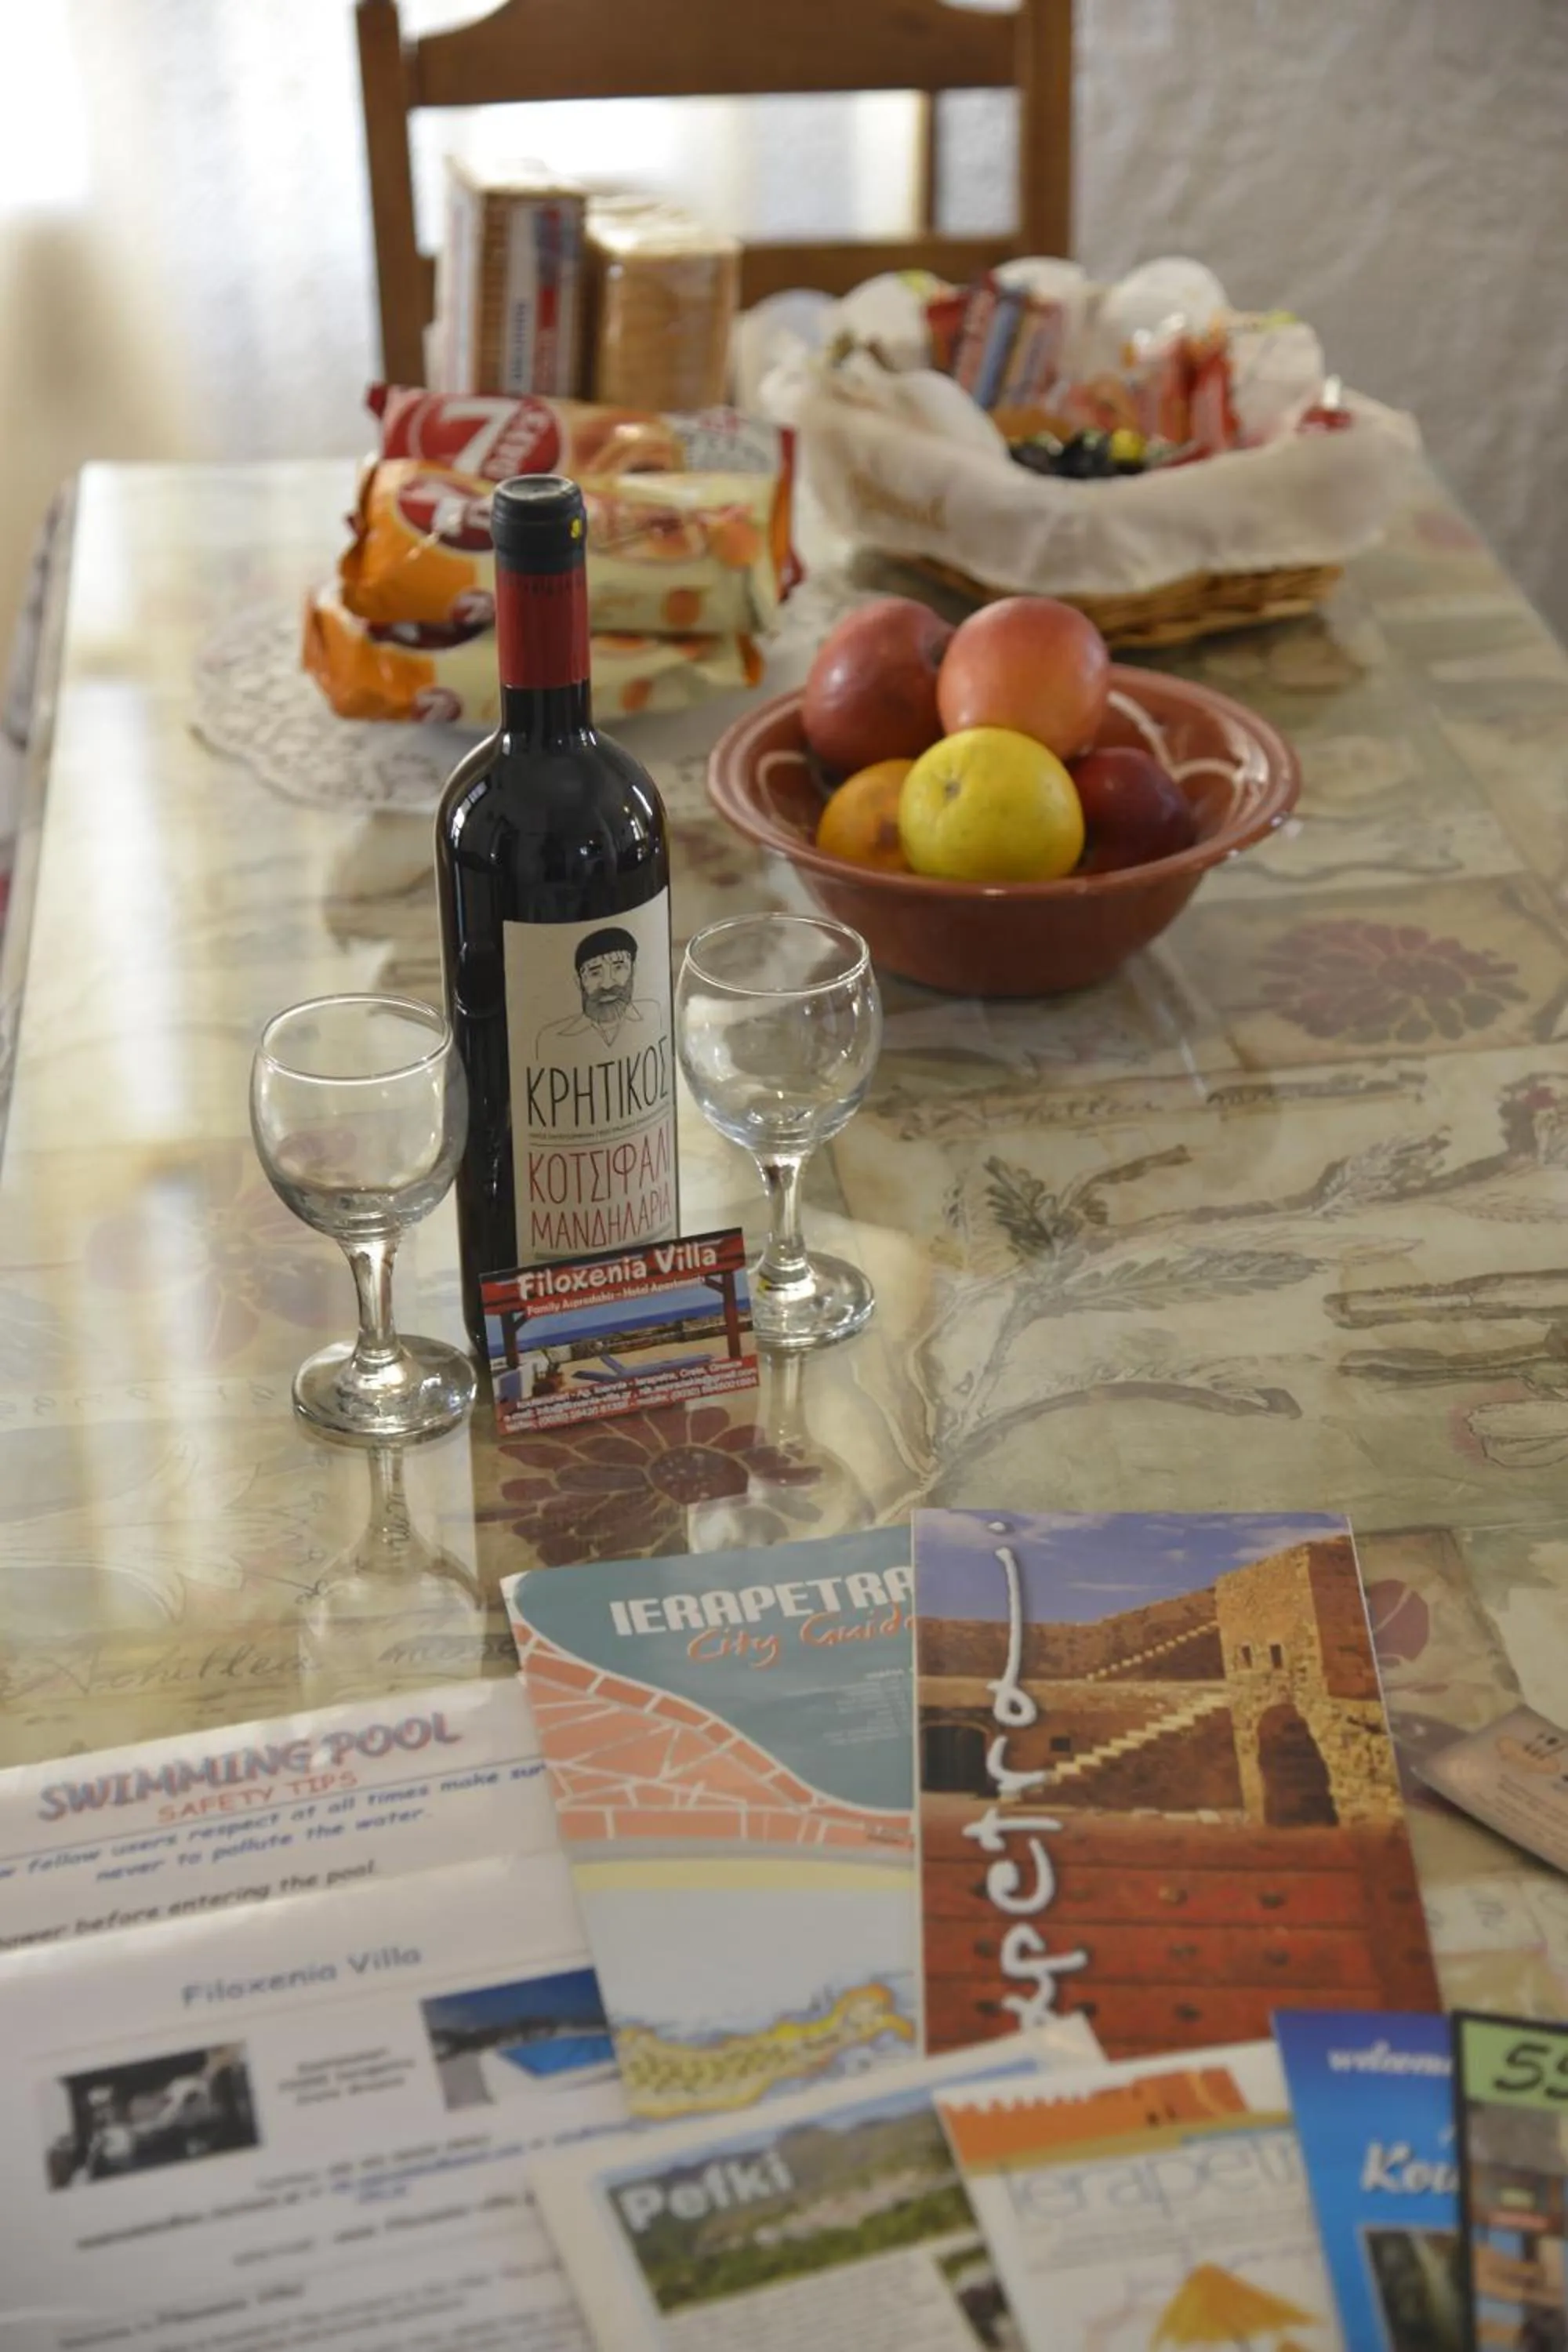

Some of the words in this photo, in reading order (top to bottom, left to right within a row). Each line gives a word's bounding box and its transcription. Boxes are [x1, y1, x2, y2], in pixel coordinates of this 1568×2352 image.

[527, 1036, 668, 1127] ΚΡΗΤΙΚΟΣ
[528, 1120, 671, 1204] ΚΟΤΣΙΦΑΛΙ
[517, 1255, 648, 1301] Filoxenia
[655, 1242, 718, 1275] Villa
[609, 1566, 914, 1636] IERAPETRA
[687, 1626, 781, 1671] City
[38, 1737, 312, 1823] SWIMMING
[321, 1711, 464, 1768] POOL
[158, 1785, 274, 1824] SAFETY
[283, 1769, 358, 1795] TIPS
[28, 1848, 101, 1874] fellow
[111, 1835, 177, 1857] users
[187, 1812, 281, 1843] respect
[328, 1796, 356, 1815] all
[368, 1784, 430, 1806] times
[440, 1771, 500, 1792] make
[96, 1860, 166, 1883] never
[177, 1851, 203, 1867] to
[211, 1831, 294, 1864] pollute
[306, 1823, 346, 1842] the
[74, 1906, 160, 1935] before
[167, 1883, 271, 1918] entering
[278, 1871, 318, 1895] the
[180, 1962, 339, 2008] Filoxenia
[347, 1944, 423, 1978] Villa
